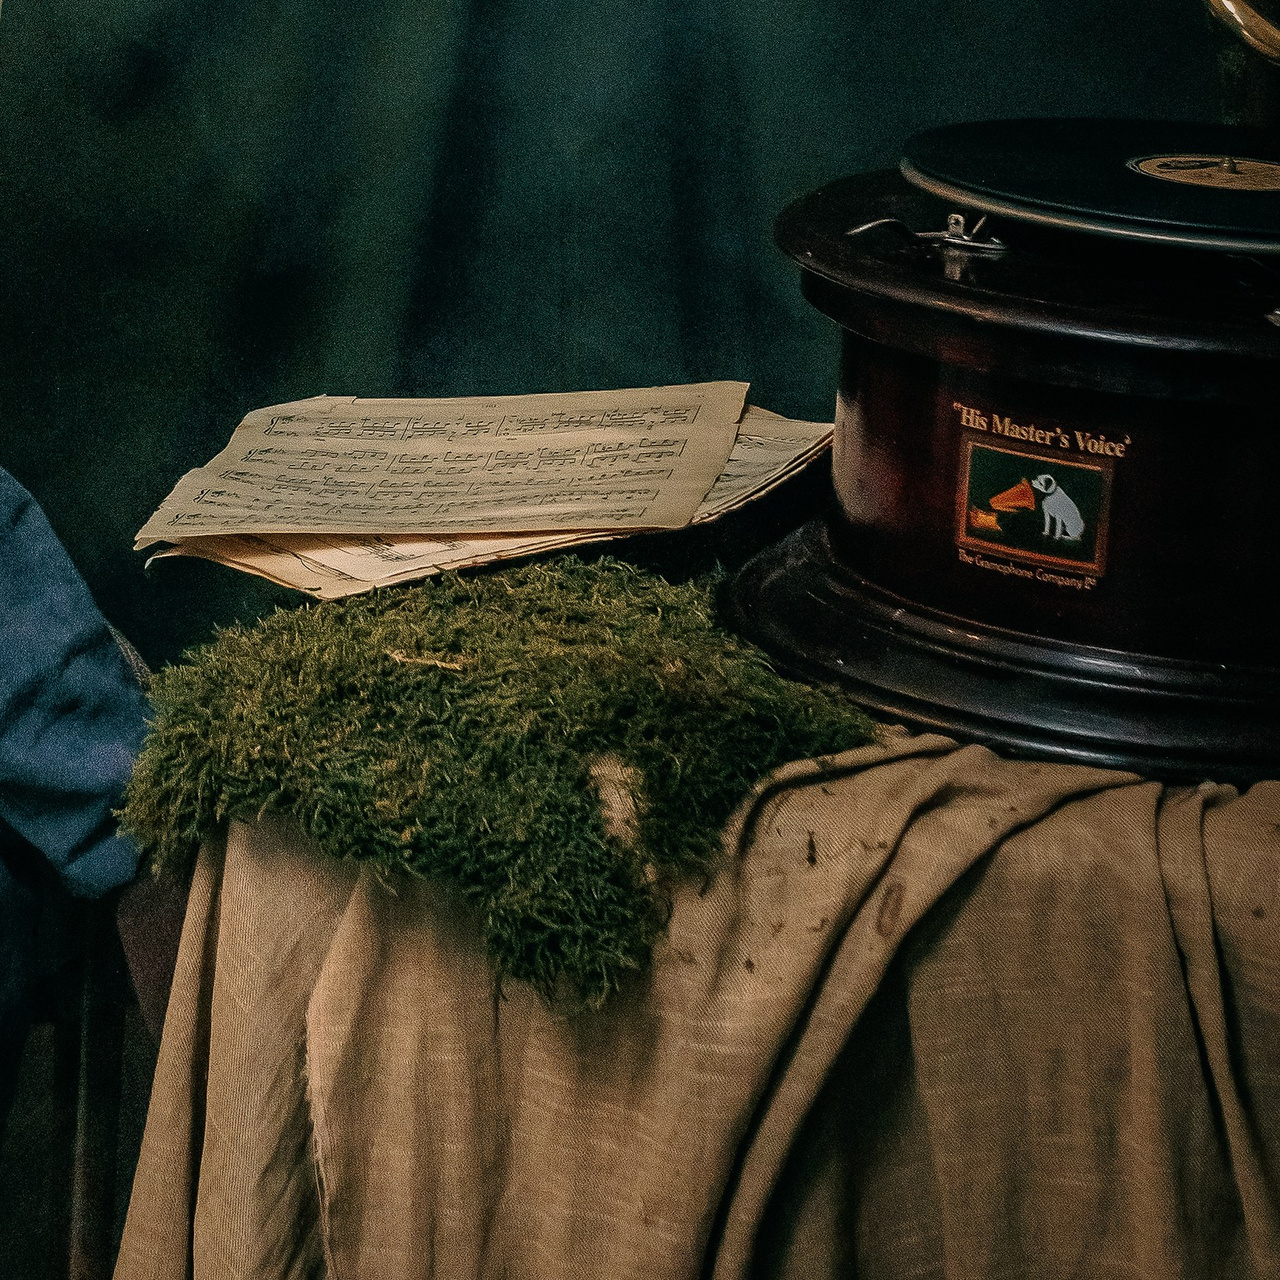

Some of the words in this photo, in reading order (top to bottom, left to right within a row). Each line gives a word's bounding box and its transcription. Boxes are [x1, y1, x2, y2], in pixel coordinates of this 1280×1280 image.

[992, 413, 1069, 449] Master's
[958, 548, 974, 564] The
[975, 554, 1033, 579] Gramophone
[1035, 568, 1083, 590] Company
